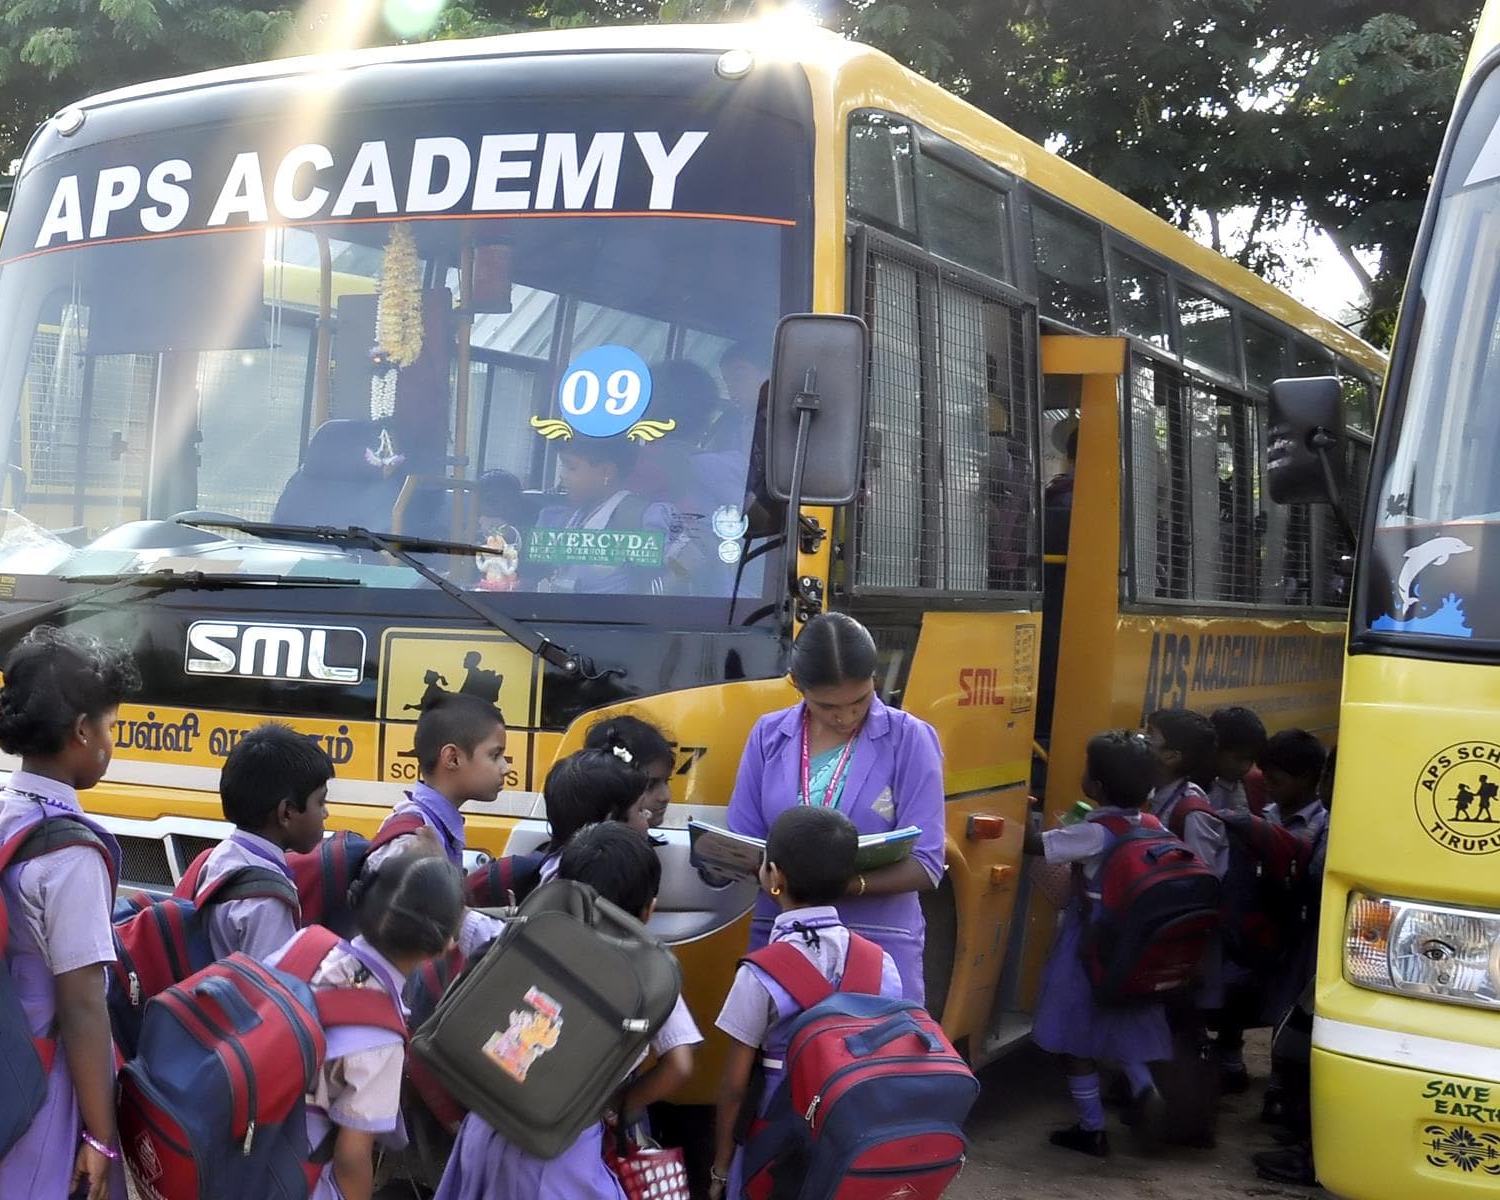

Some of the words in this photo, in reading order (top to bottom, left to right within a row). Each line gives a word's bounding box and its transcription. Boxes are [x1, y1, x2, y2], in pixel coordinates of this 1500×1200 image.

[34, 158, 192, 249] APS
[207, 131, 709, 227] ACADEMY
[562, 369, 641, 416] 09
[548, 532, 658, 550] MERCYDA
[188, 624, 359, 683] SML
[1191, 634, 1261, 691] ACADEMY
[958, 668, 1005, 706] SML
[115, 711, 200, 753] பள்ளி
[1421, 755, 1452, 792] APS
[1422, 1080, 1490, 1103] SAVE
